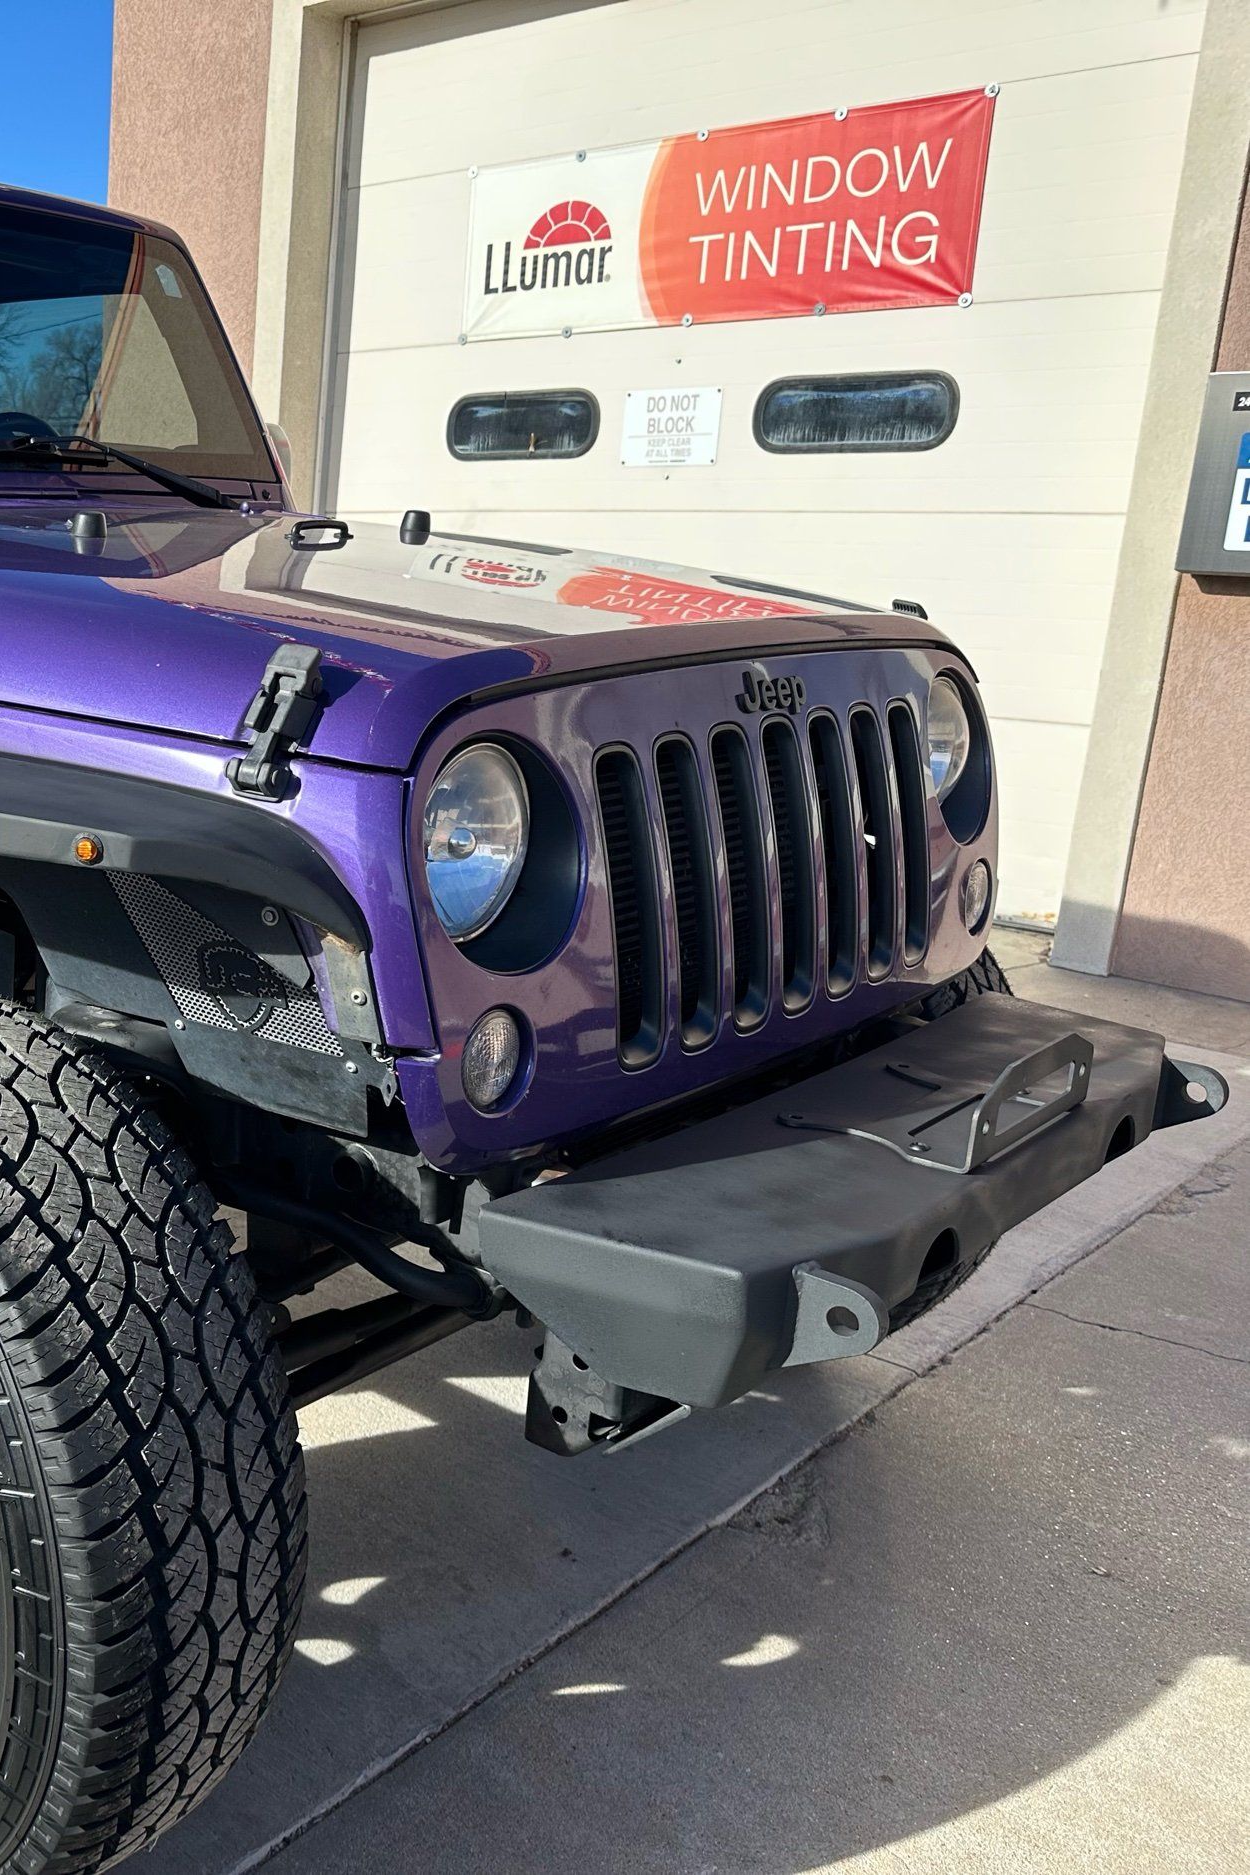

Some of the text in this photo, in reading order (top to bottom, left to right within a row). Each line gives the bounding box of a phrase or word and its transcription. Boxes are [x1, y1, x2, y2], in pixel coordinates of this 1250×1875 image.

[695, 137, 952, 216] WINDOW
[688, 210, 940, 284] TINTING
[647, 394, 699, 412] DO NOT
[647, 417, 695, 433] BLOCK
[648, 437, 691, 447] KEEP CLEAR
[646, 448, 691, 457] AT ALL TIMES
[734, 670, 807, 715] Jeep
